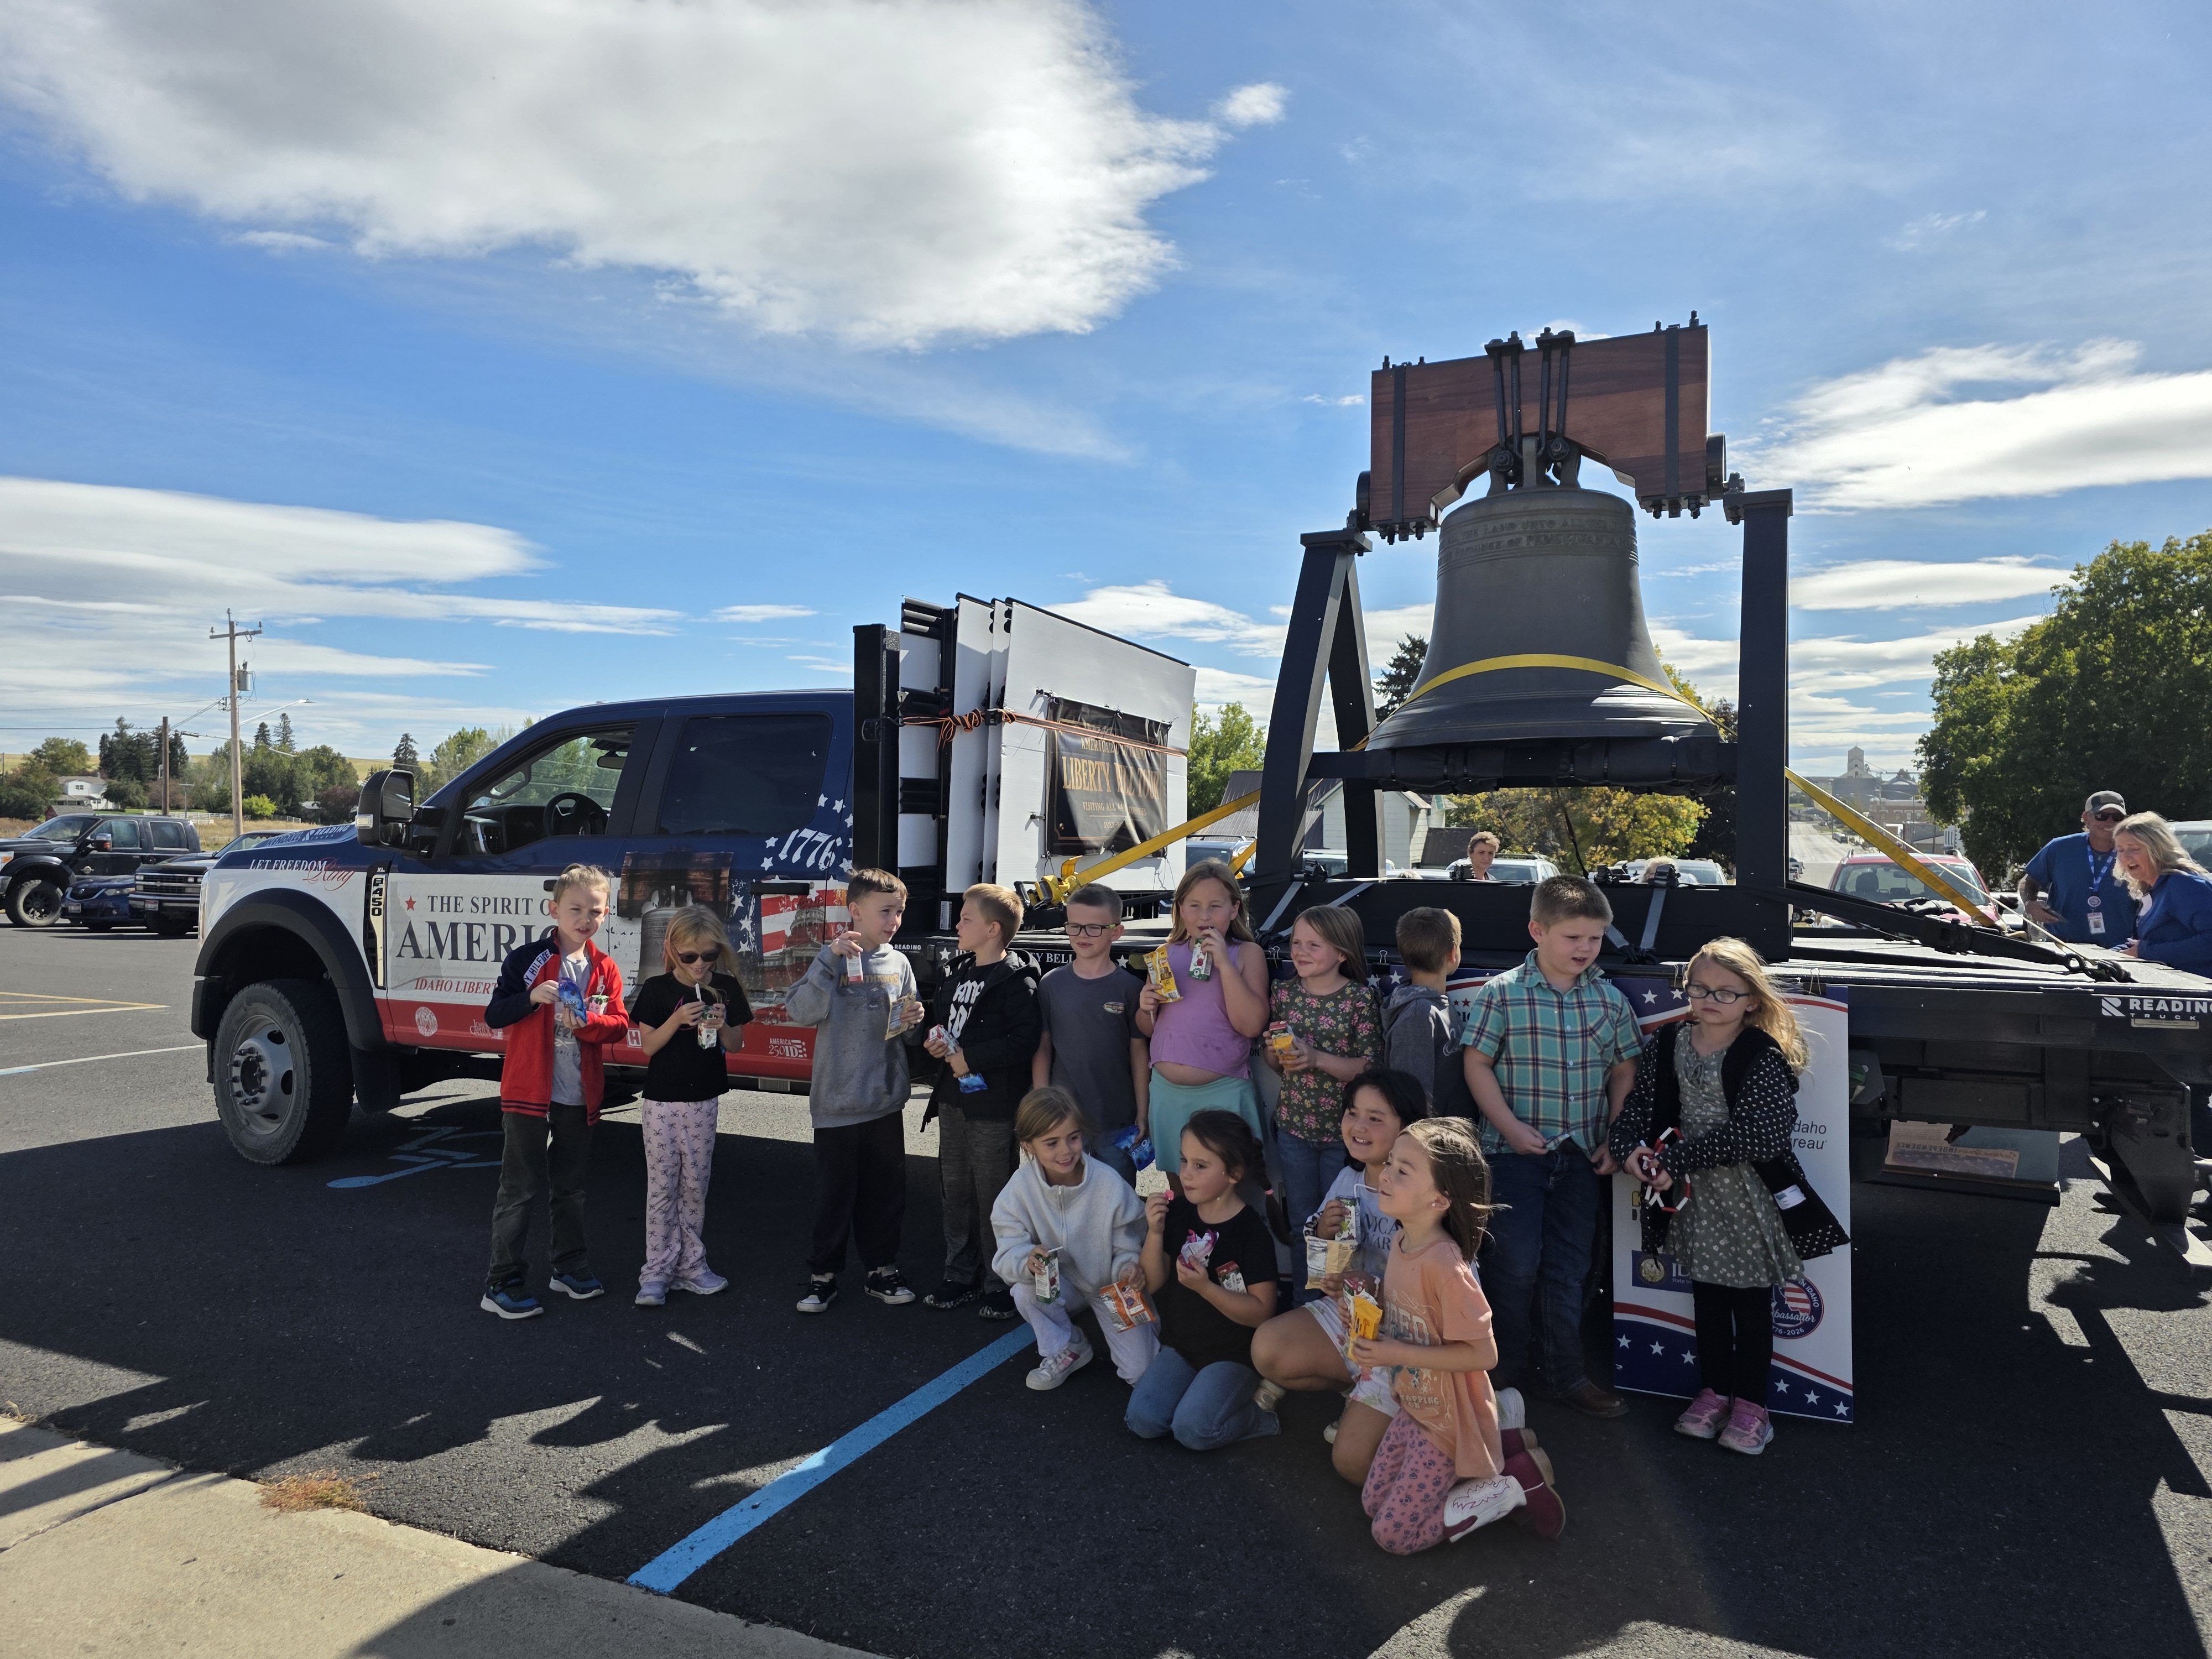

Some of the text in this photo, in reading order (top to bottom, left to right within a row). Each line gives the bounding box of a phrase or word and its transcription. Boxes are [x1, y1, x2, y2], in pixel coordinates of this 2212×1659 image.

[1062, 756, 1112, 792] LIBERTY
[1137, 768, 1160, 801] TOUR
[1082, 801, 1105, 811] VISITING
[1106, 802, 1117, 811] ALL
[314, 825, 351, 837] READING
[778, 828, 843, 871] 1776
[249, 859, 327, 872] LET FREEDOM
[302, 857, 356, 891] Ring
[371, 878, 384, 916] F450
[427, 895, 551, 916] THE SPIRIT O
[1046, 952, 1073, 964] BELL
[414, 978, 498, 995] IDAHO LIBERT
[839, 972, 900, 988] NTHAWKS
[2130, 998, 2212, 1013] READIN
[2130, 1013, 2197, 1021] TRUCK
[769, 1037, 792, 1046] AMERICA
[768, 1045, 785, 1058] 250
[1792, 1138, 1824, 1150] reau
[1805, 1285, 1819, 1308] IDAHO
[1408, 1401, 1421, 1410] ON
